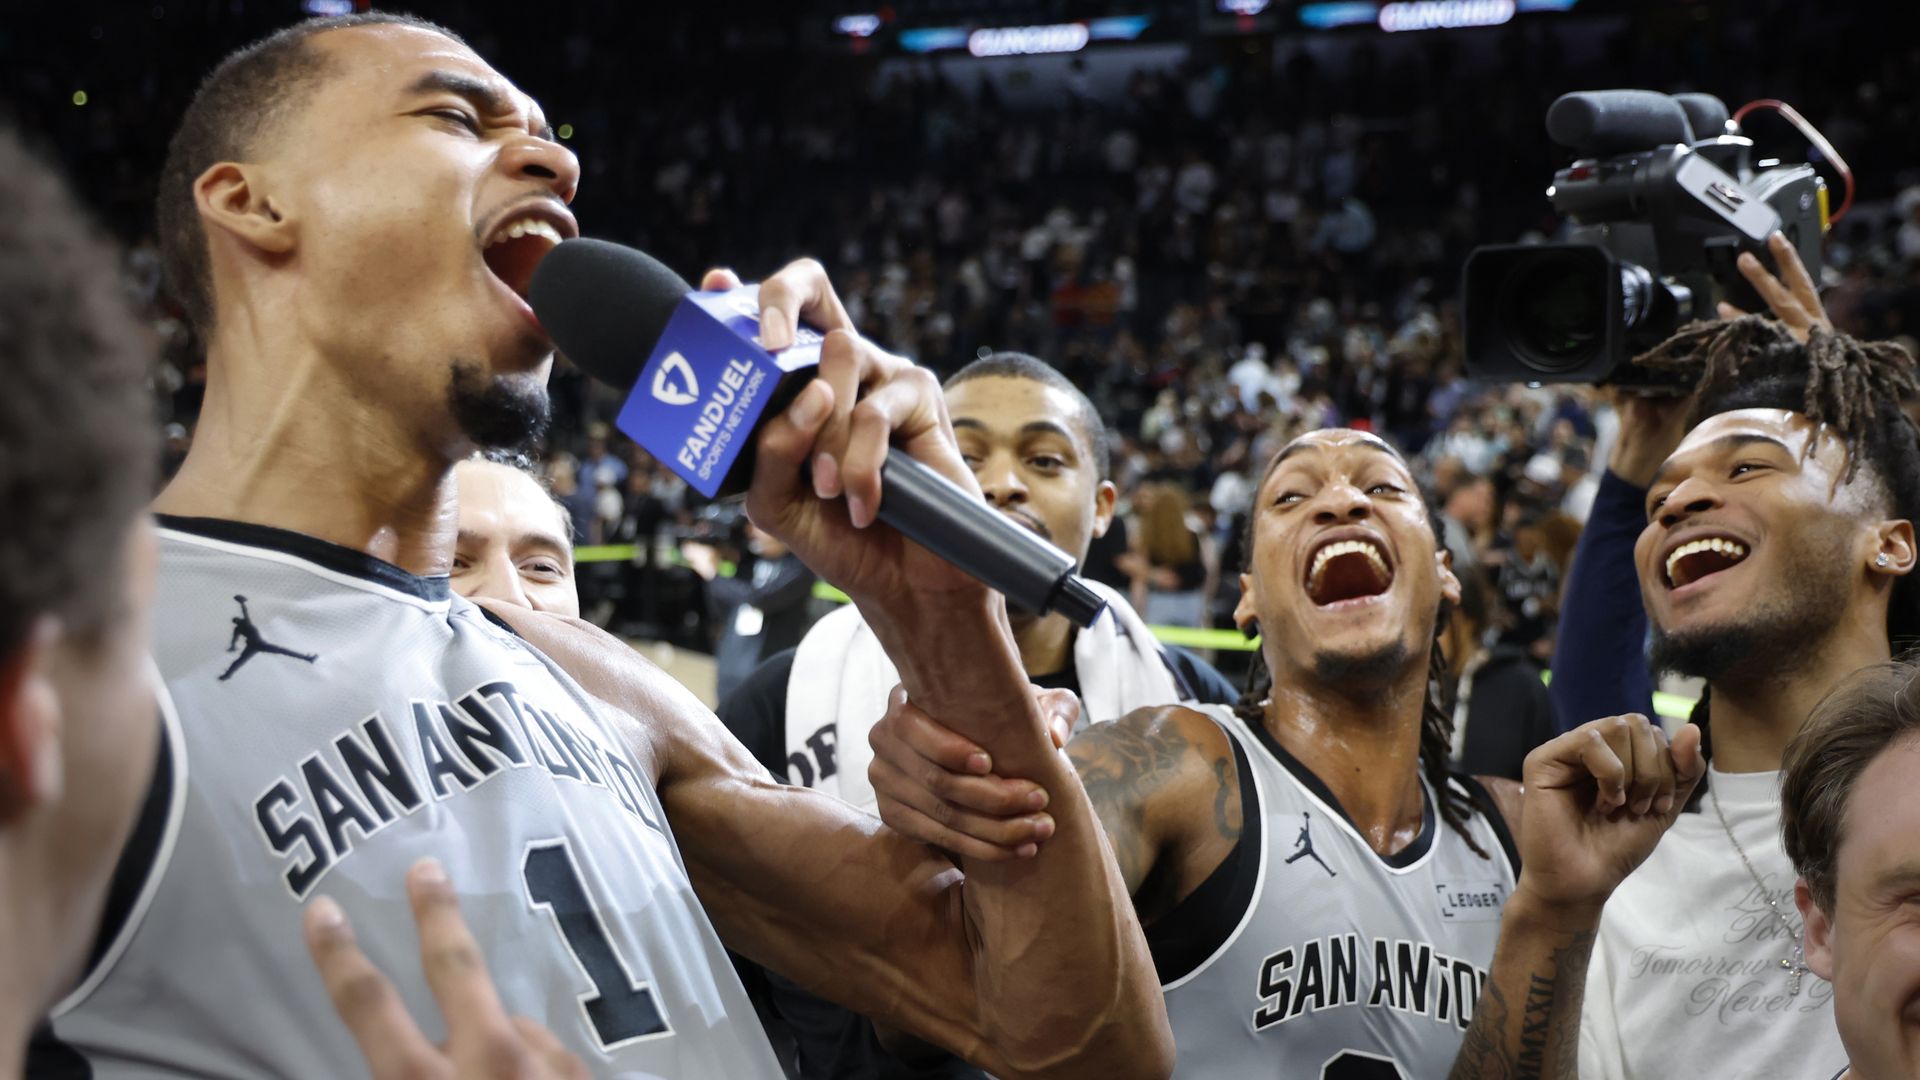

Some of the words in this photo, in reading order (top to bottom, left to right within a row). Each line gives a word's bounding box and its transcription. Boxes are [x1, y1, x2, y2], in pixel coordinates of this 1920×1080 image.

[677, 359, 753, 471] FANDUEL
[698, 430, 732, 481] SPORTS
[724, 368, 767, 433] NETWORK
[253, 711, 425, 902] SAN
[520, 836, 675, 1053] 1
[1447, 892, 1500, 908] LEDGER
[1253, 932, 1356, 1033] SAN
